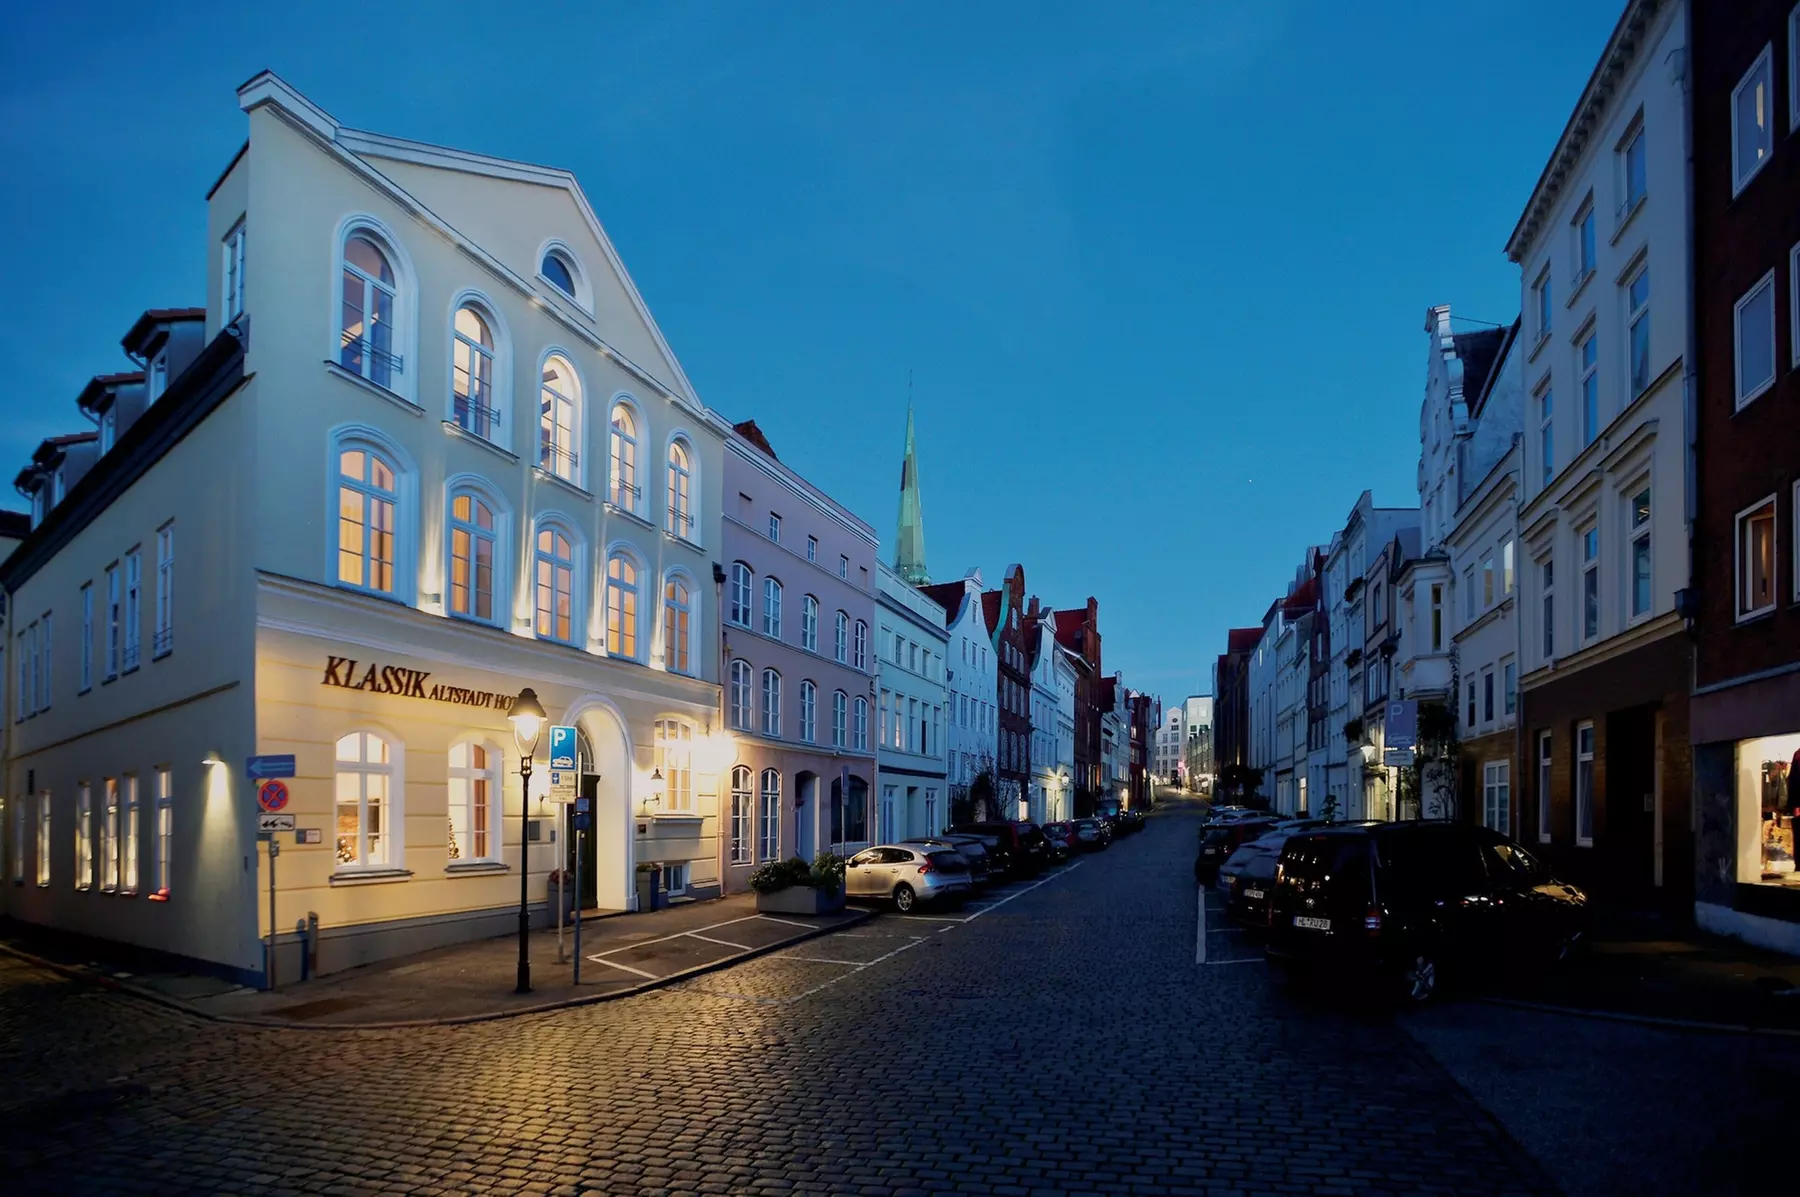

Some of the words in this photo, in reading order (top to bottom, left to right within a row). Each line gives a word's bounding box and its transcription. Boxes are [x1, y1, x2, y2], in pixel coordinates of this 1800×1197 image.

[321, 656, 431, 698] KLASSIK
[429, 684, 494, 708] ALTSTADT
[1391, 705, 1403, 722] P
[554, 729, 566, 747] P
